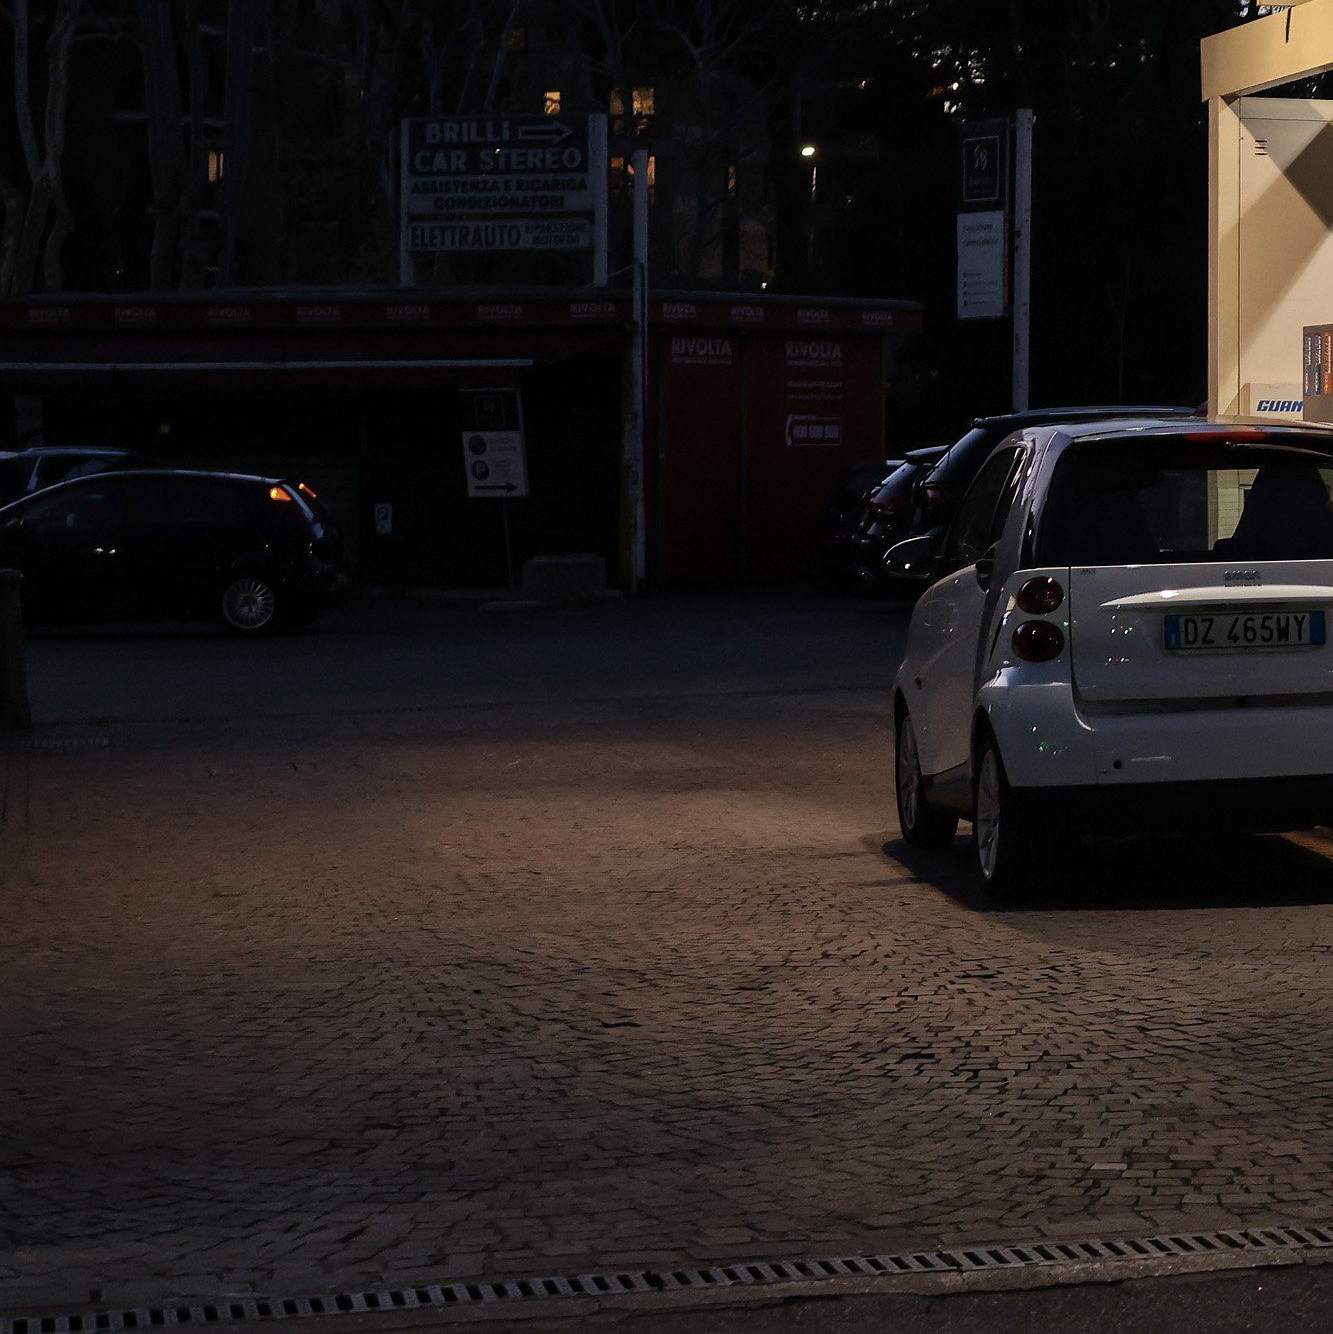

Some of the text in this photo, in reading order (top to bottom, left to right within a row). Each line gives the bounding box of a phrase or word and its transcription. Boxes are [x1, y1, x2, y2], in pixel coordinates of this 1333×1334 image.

[425, 121, 509, 143] BRILLI
[414, 147, 582, 172] CAR STEREO
[412, 179, 498, 194] ASSISTENZA
[516, 177, 588, 192] RICARICA
[433, 195, 564, 210] CONDIZIONATORI
[411, 224, 521, 249] ELETTRAUTO
[671, 338, 733, 356] RIVOLTA
[785, 341, 843, 358] RIVOLTA
[1184, 614, 1306, 645] DZ 465WY
